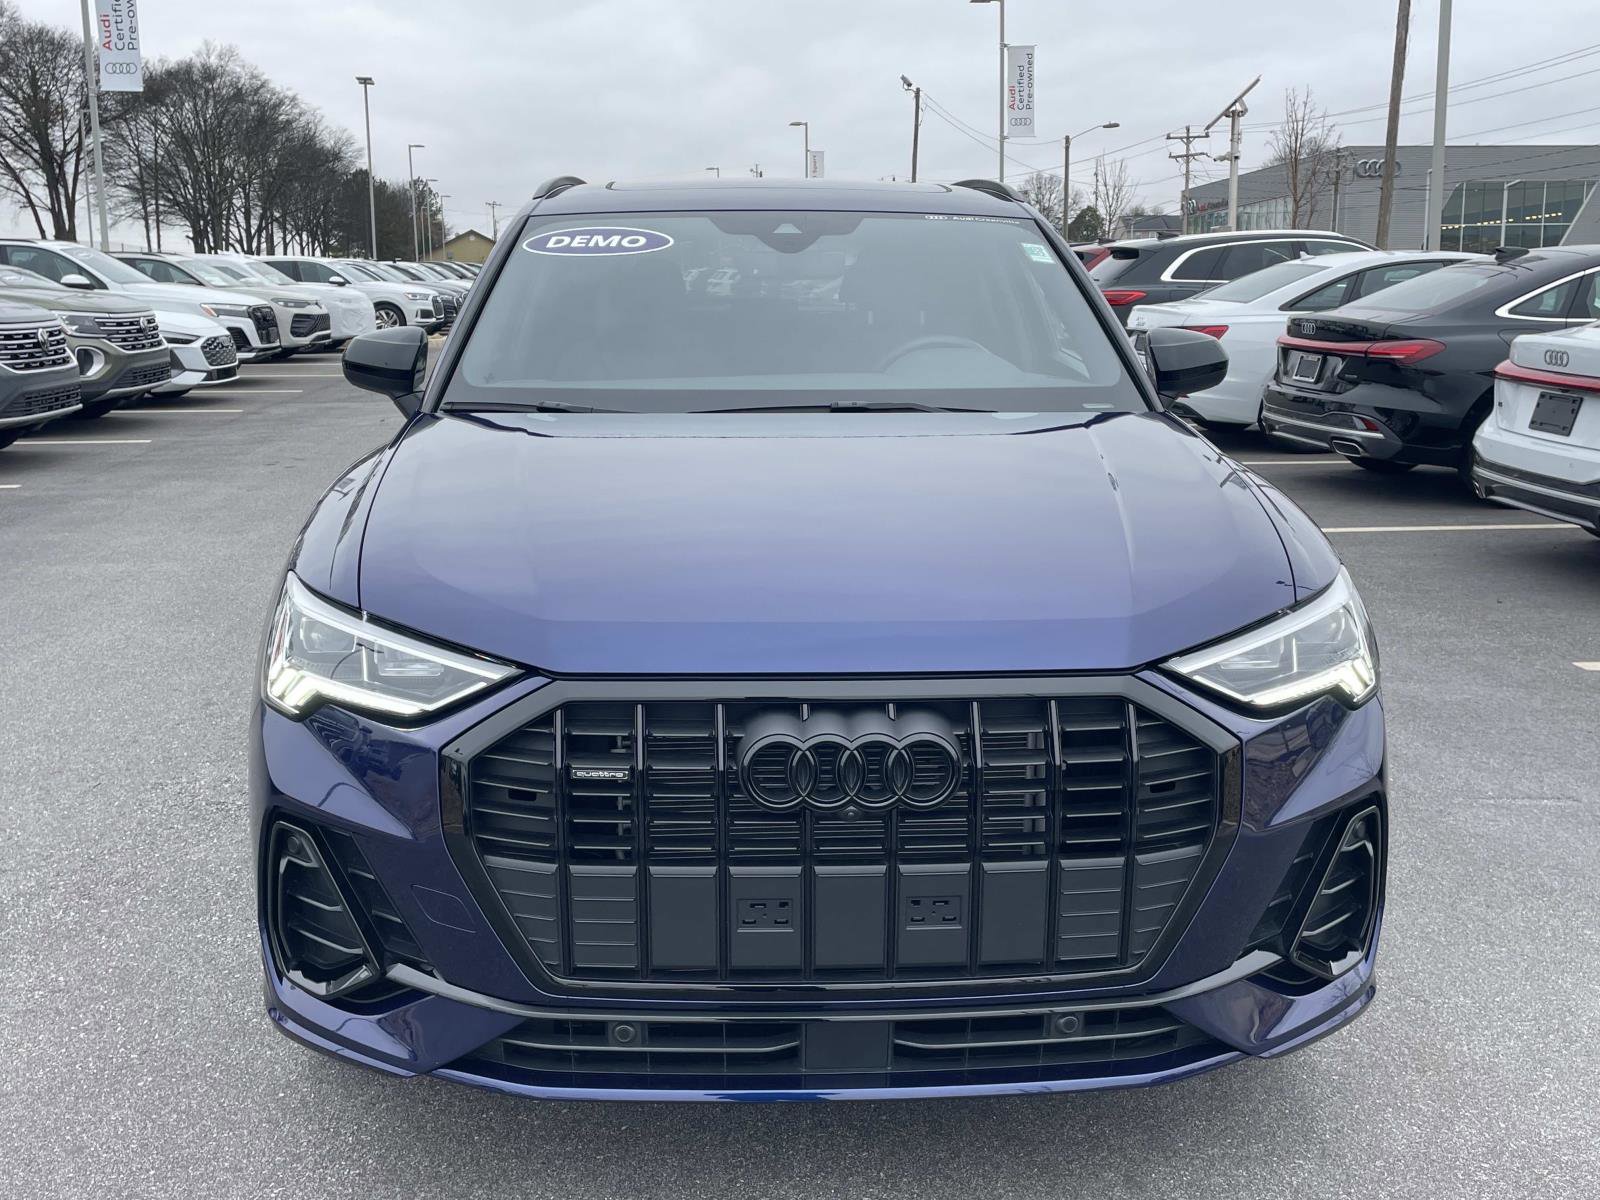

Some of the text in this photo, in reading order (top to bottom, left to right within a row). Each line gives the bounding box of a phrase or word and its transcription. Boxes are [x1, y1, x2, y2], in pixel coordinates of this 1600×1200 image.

[100, 14, 112, 51] Audi
[1008, 85, 1016, 111] Audi
[1017, 65, 1025, 110] Certified
[1025, 53, 1033, 110] Pre-owned
[546, 235, 647, 248] DEMO
